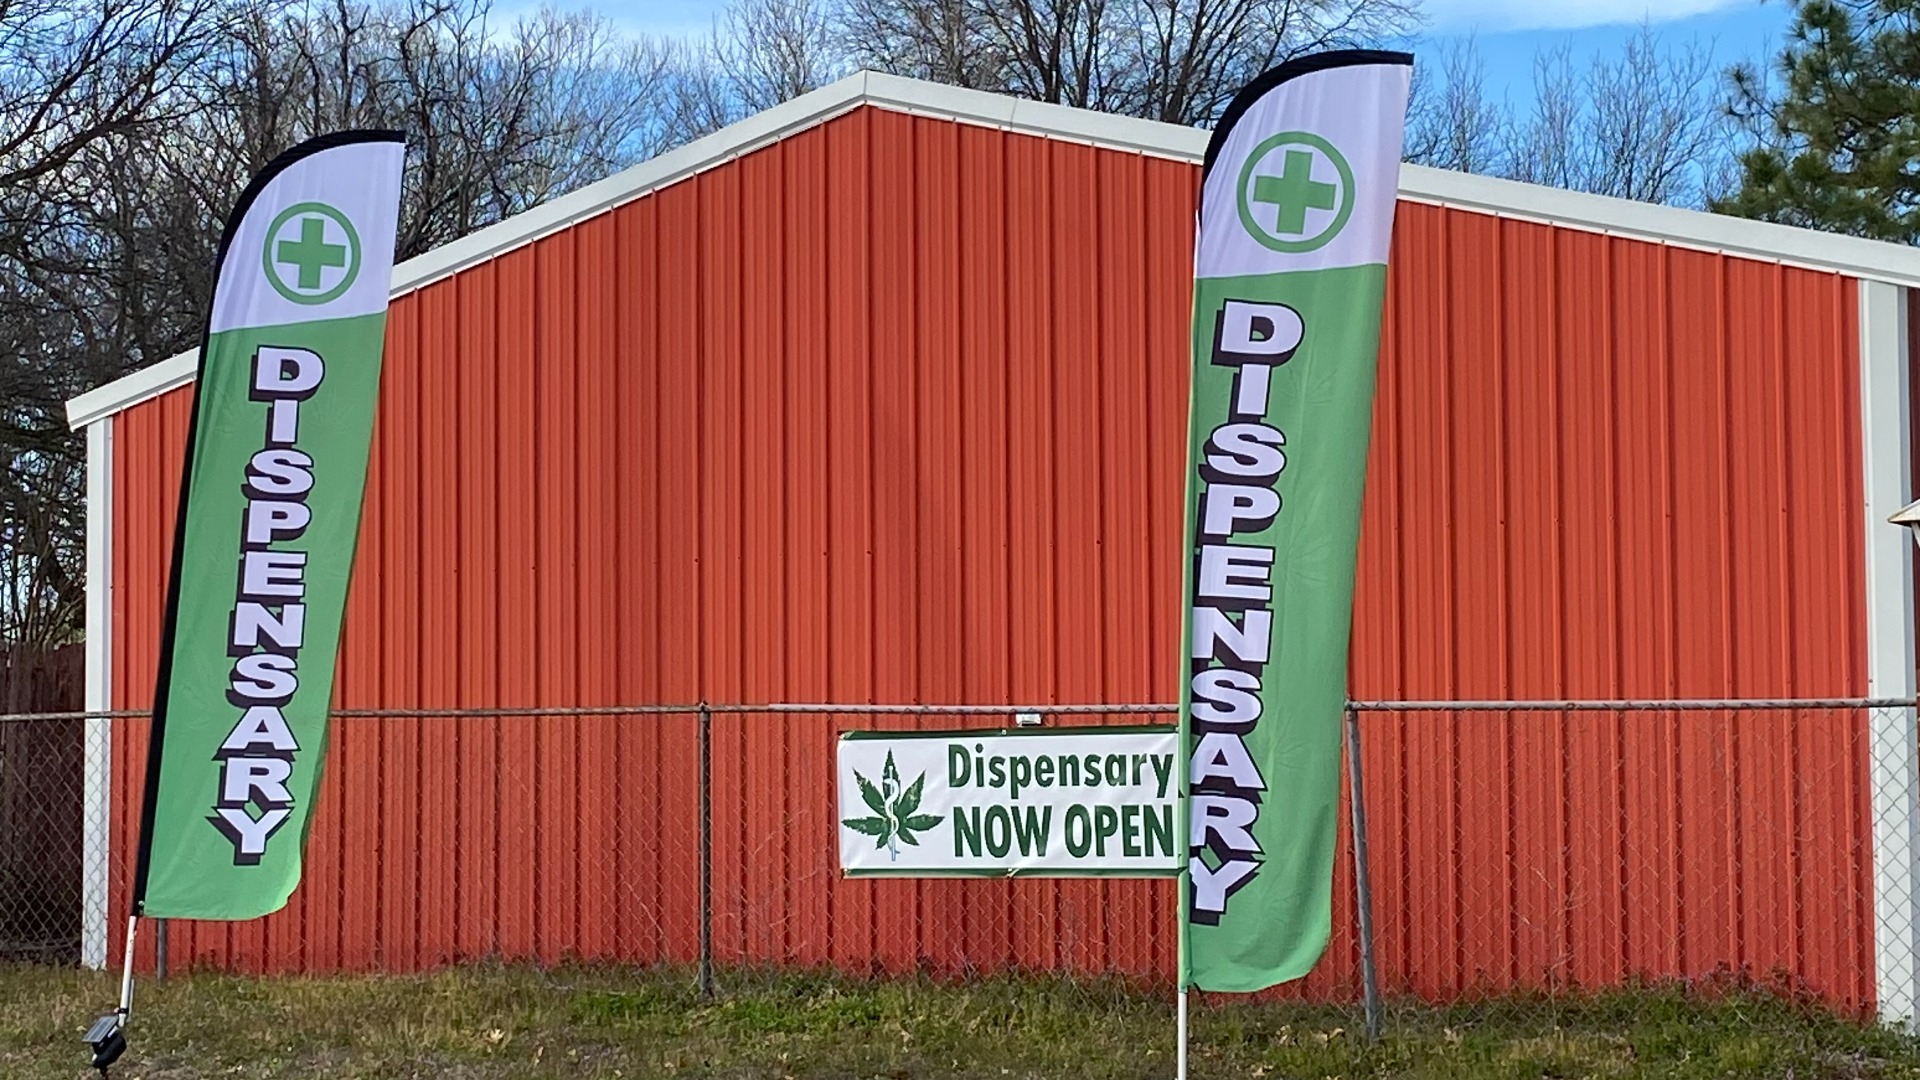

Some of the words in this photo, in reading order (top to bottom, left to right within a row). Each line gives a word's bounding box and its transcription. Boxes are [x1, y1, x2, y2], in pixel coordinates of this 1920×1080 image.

[207, 345, 325, 865] DISPENSARY
[1189, 298, 1305, 926] DISPENSARY
[948, 743, 1174, 799] Dispensary
[954, 804, 1052, 858] NOW
[1064, 803, 1174, 858] OPEN
